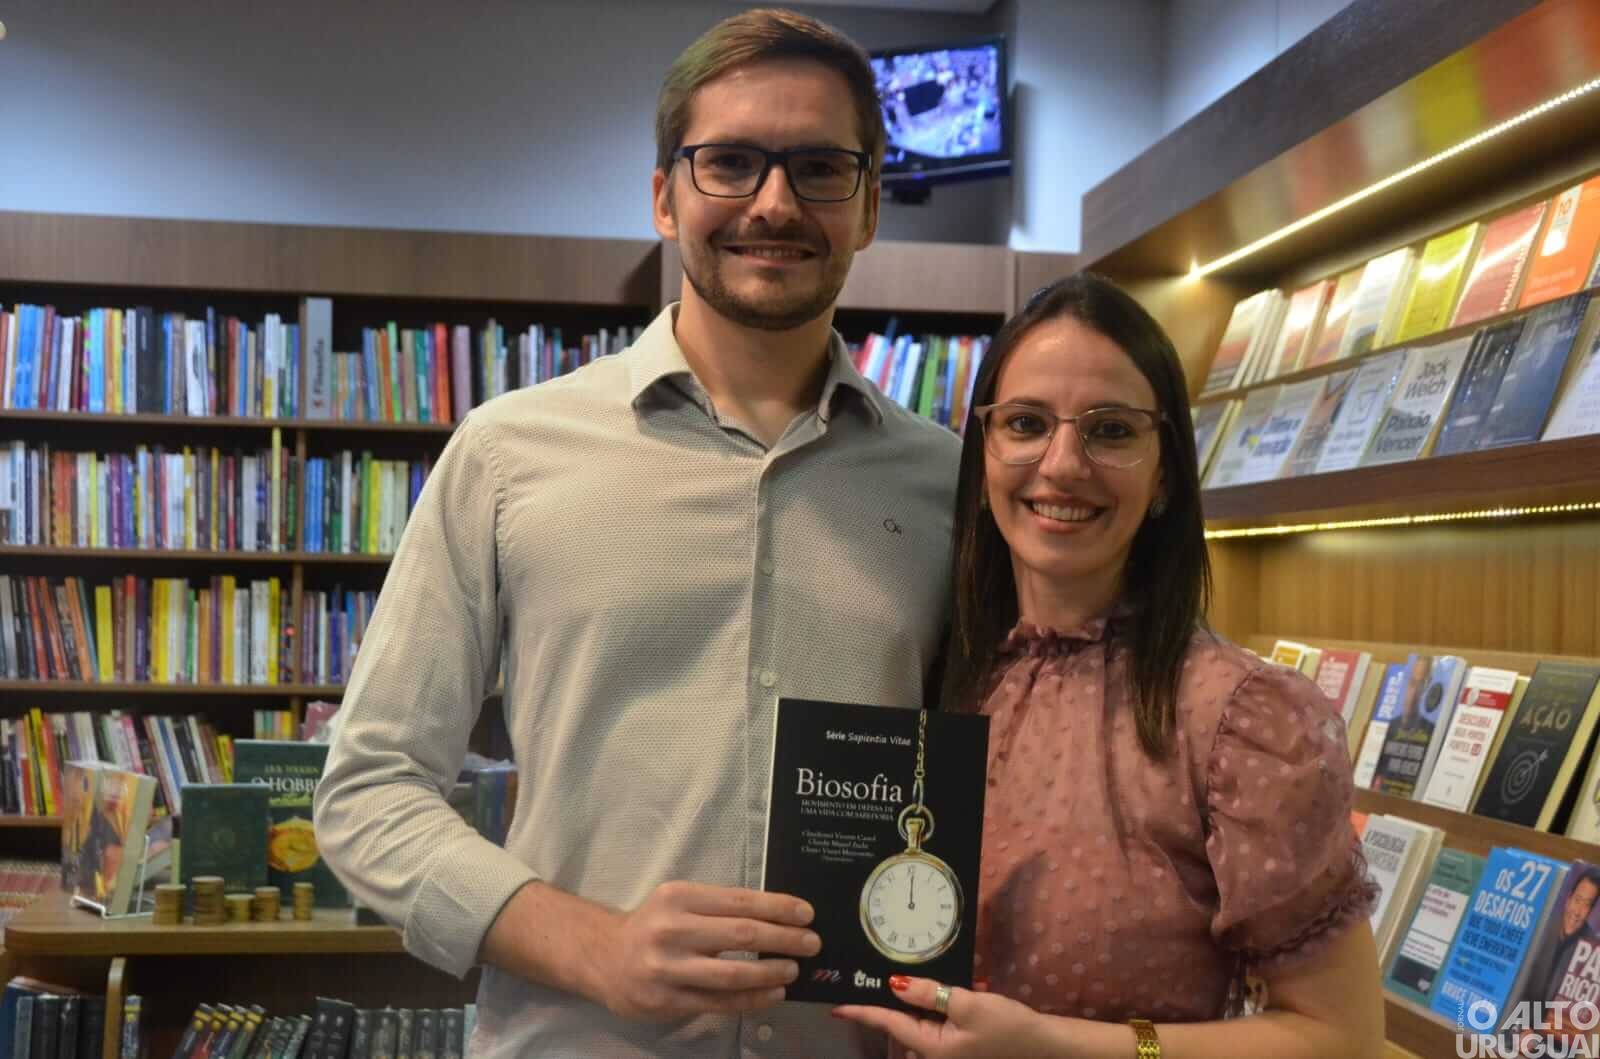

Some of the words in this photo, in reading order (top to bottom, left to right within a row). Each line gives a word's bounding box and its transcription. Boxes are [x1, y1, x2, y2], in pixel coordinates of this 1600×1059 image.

[1420, 355, 1450, 380] Jack
[1520, 703, 1572, 735] AÇÃO
[795, 767, 903, 804] Biosofia
[1496, 868, 1515, 890] OS
[1510, 861, 1552, 901] 27
[1473, 890, 1535, 928] DESAFIOS
[1558, 974, 1600, 1003] RICO
